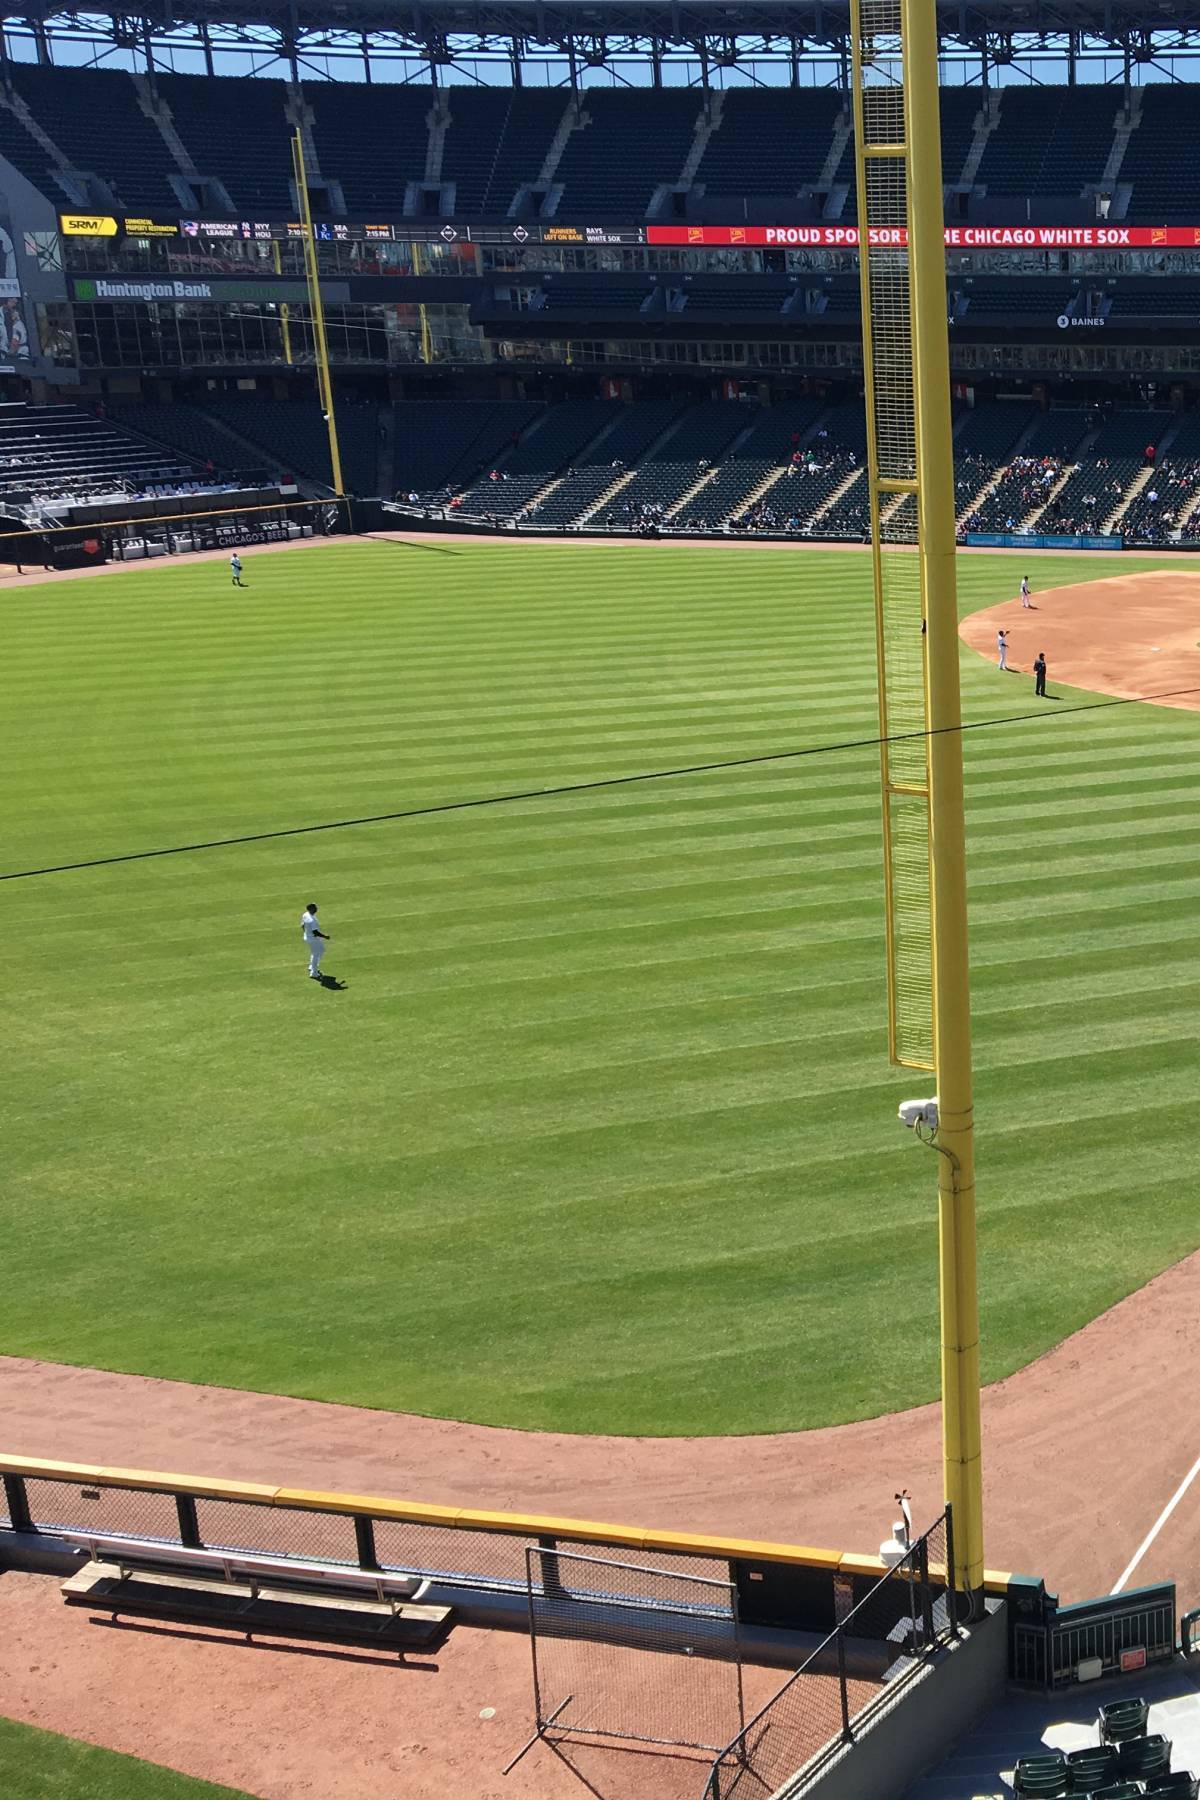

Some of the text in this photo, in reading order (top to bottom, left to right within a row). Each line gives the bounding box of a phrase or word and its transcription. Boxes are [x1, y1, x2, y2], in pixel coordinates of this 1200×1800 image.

[68, 220, 98, 229] SRM
[200, 223, 238, 231] AMERICAN
[333, 224, 348, 232] SEA
[206, 229, 234, 237] LEAGUE
[254, 231, 272, 239] HOU
[366, 230, 390, 238] 7:15 PM
[586, 227, 603, 235] RAYS
[336, 232, 347, 240] KC
[766, 228, 820, 243] PROUD
[826, 229, 901, 244] SPOSOR
[965, 229, 1036, 244] CHICAGO
[1039, 229, 1093, 244] WHITE
[1096, 229, 1130, 244] SOX
[96, 281, 173, 300] Huntington
[174, 281, 211, 297] Bank
[1071, 317, 1105, 326] BAINES
[219, 529, 287, 546] CHICAGO'S BEER
